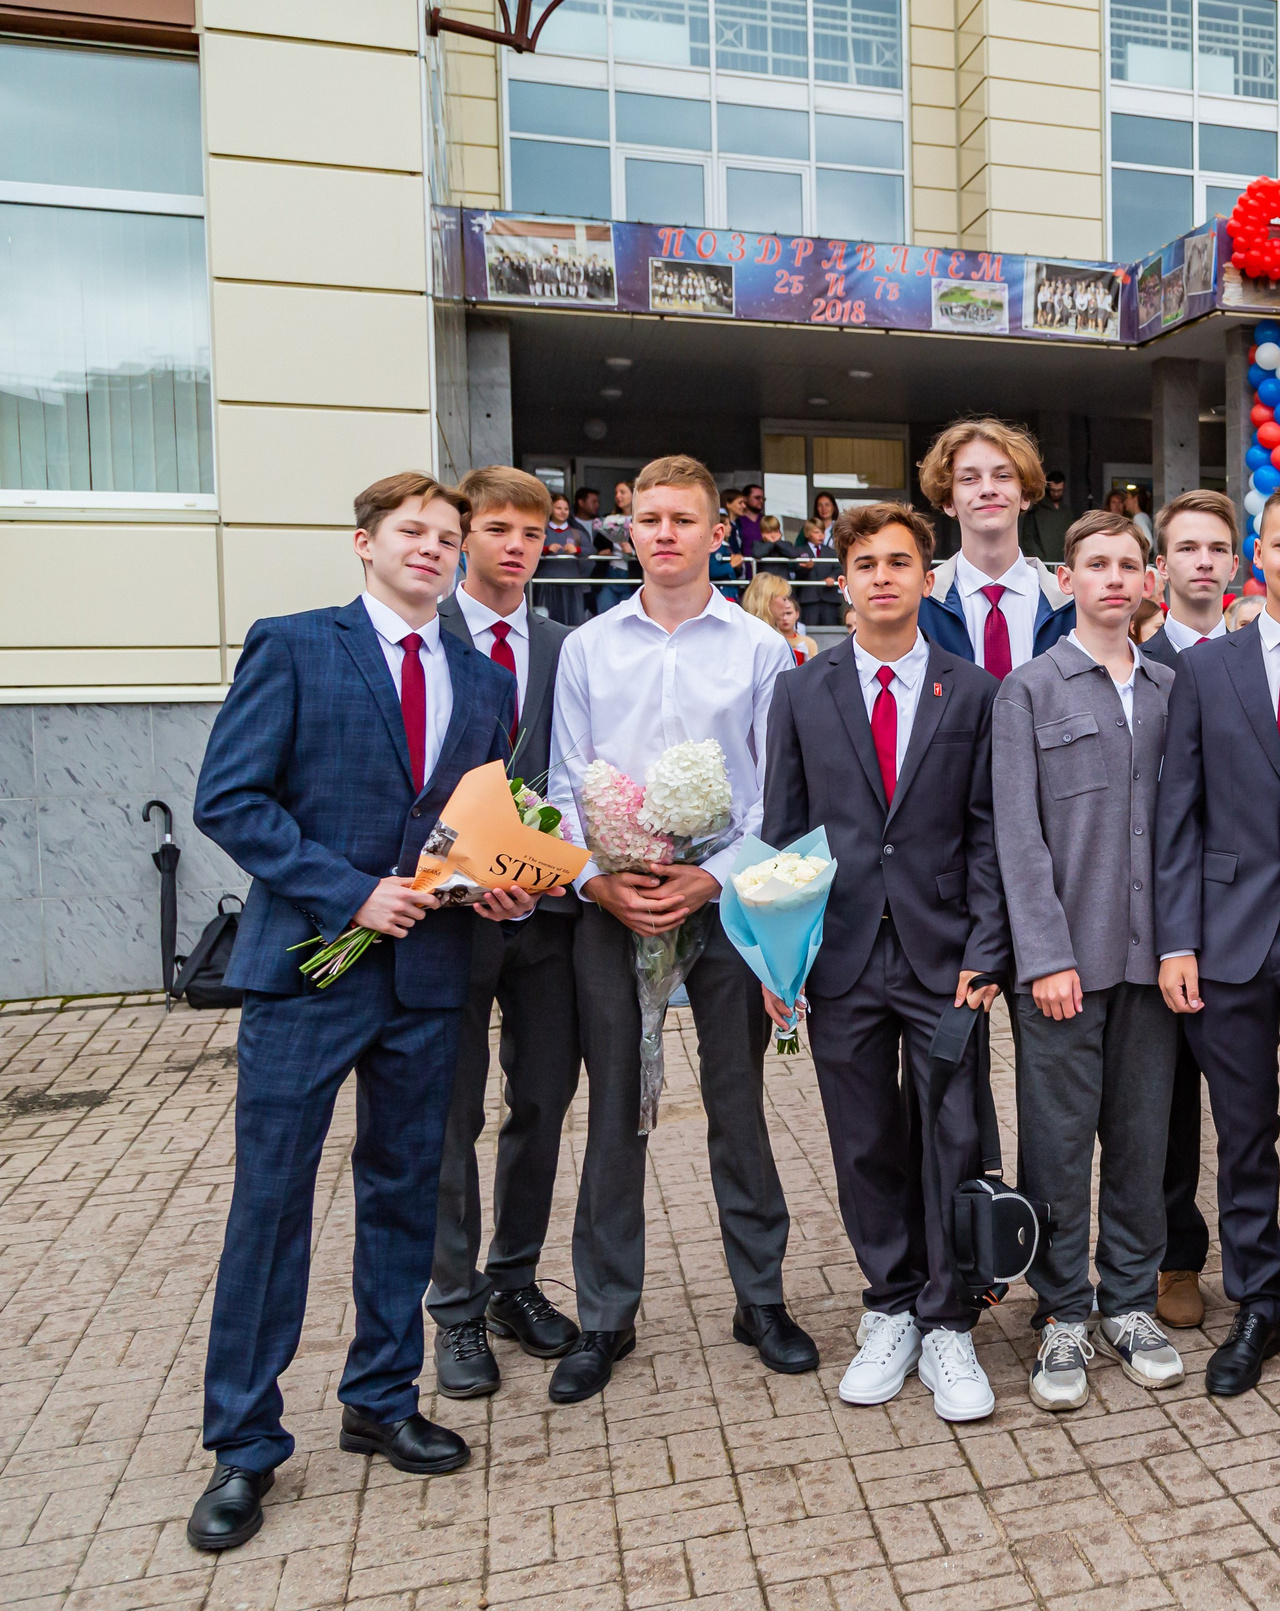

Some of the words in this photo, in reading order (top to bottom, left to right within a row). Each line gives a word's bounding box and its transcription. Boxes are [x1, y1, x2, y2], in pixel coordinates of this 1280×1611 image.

[657, 227, 1005, 282] ПОЗДРАВЛЯЕМ
[825, 272, 846, 298] И
[811, 297, 866, 324] 2018
[418, 866, 441, 877] DREAM
[489, 853, 575, 888] STYL
